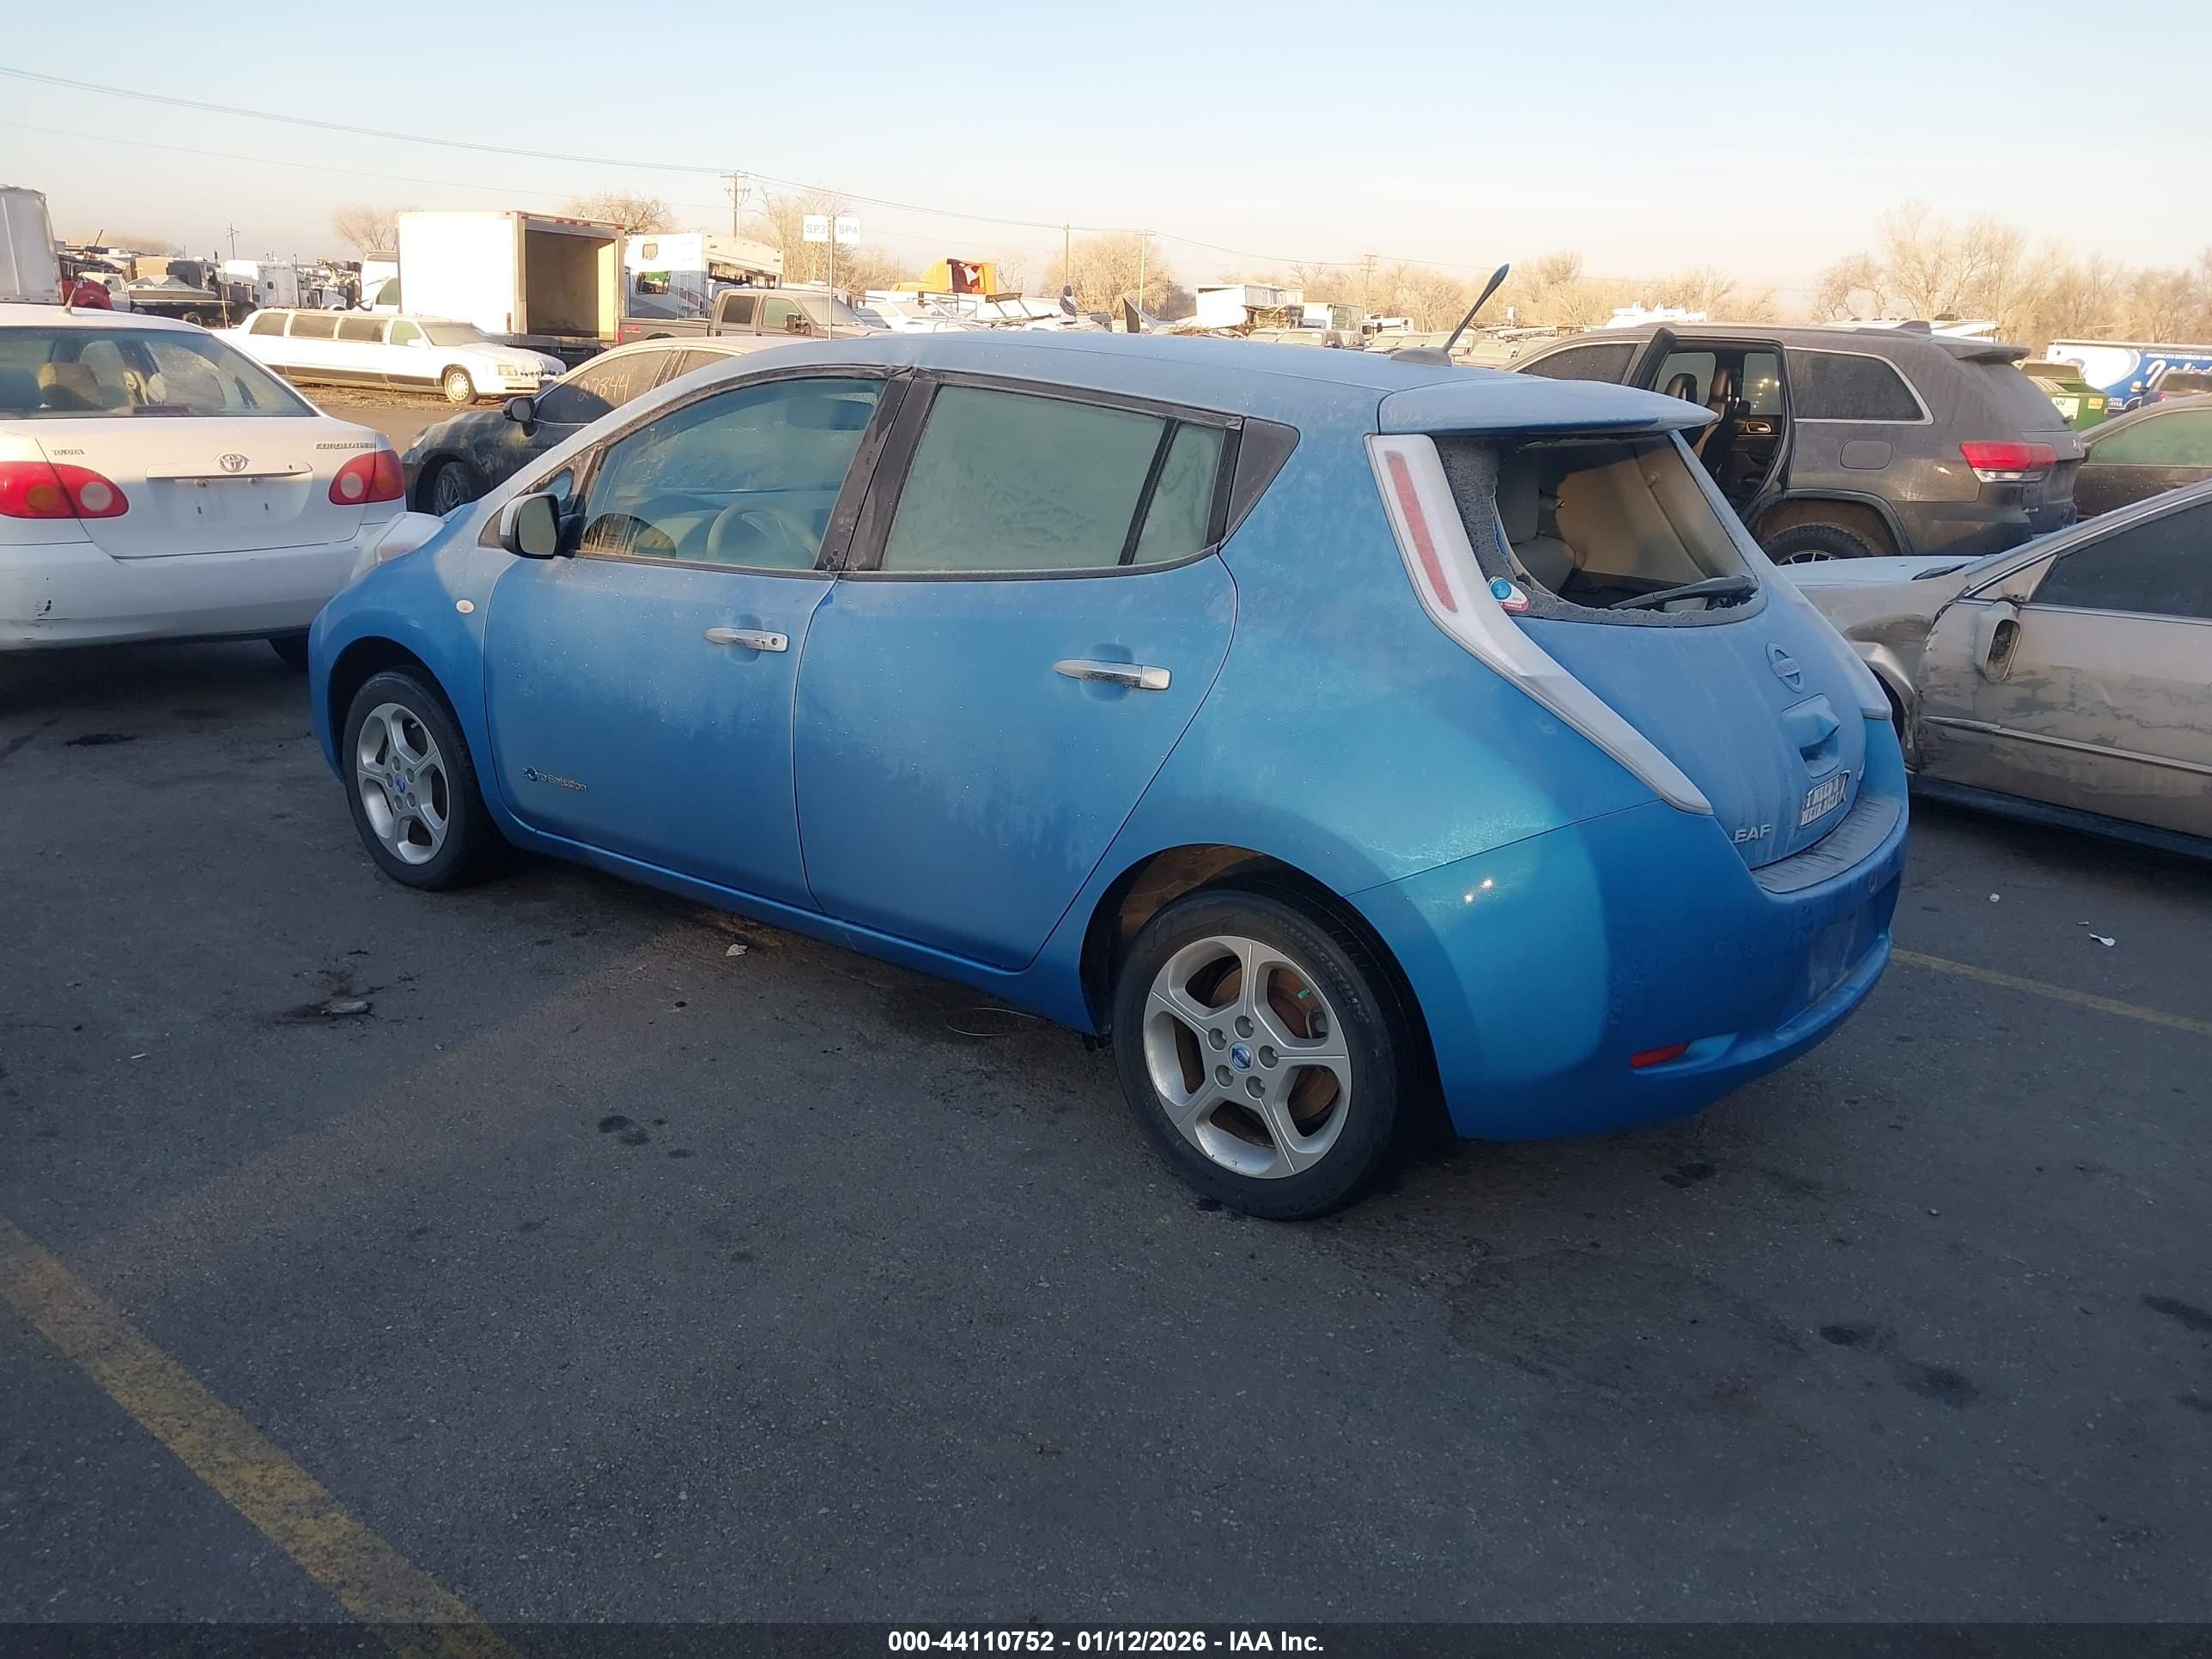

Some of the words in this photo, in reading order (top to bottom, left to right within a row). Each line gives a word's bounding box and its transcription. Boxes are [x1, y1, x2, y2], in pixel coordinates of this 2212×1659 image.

[805, 223, 826, 234] SP3
[838, 223, 859, 234] SP4
[577, 370, 631, 404] 27844
